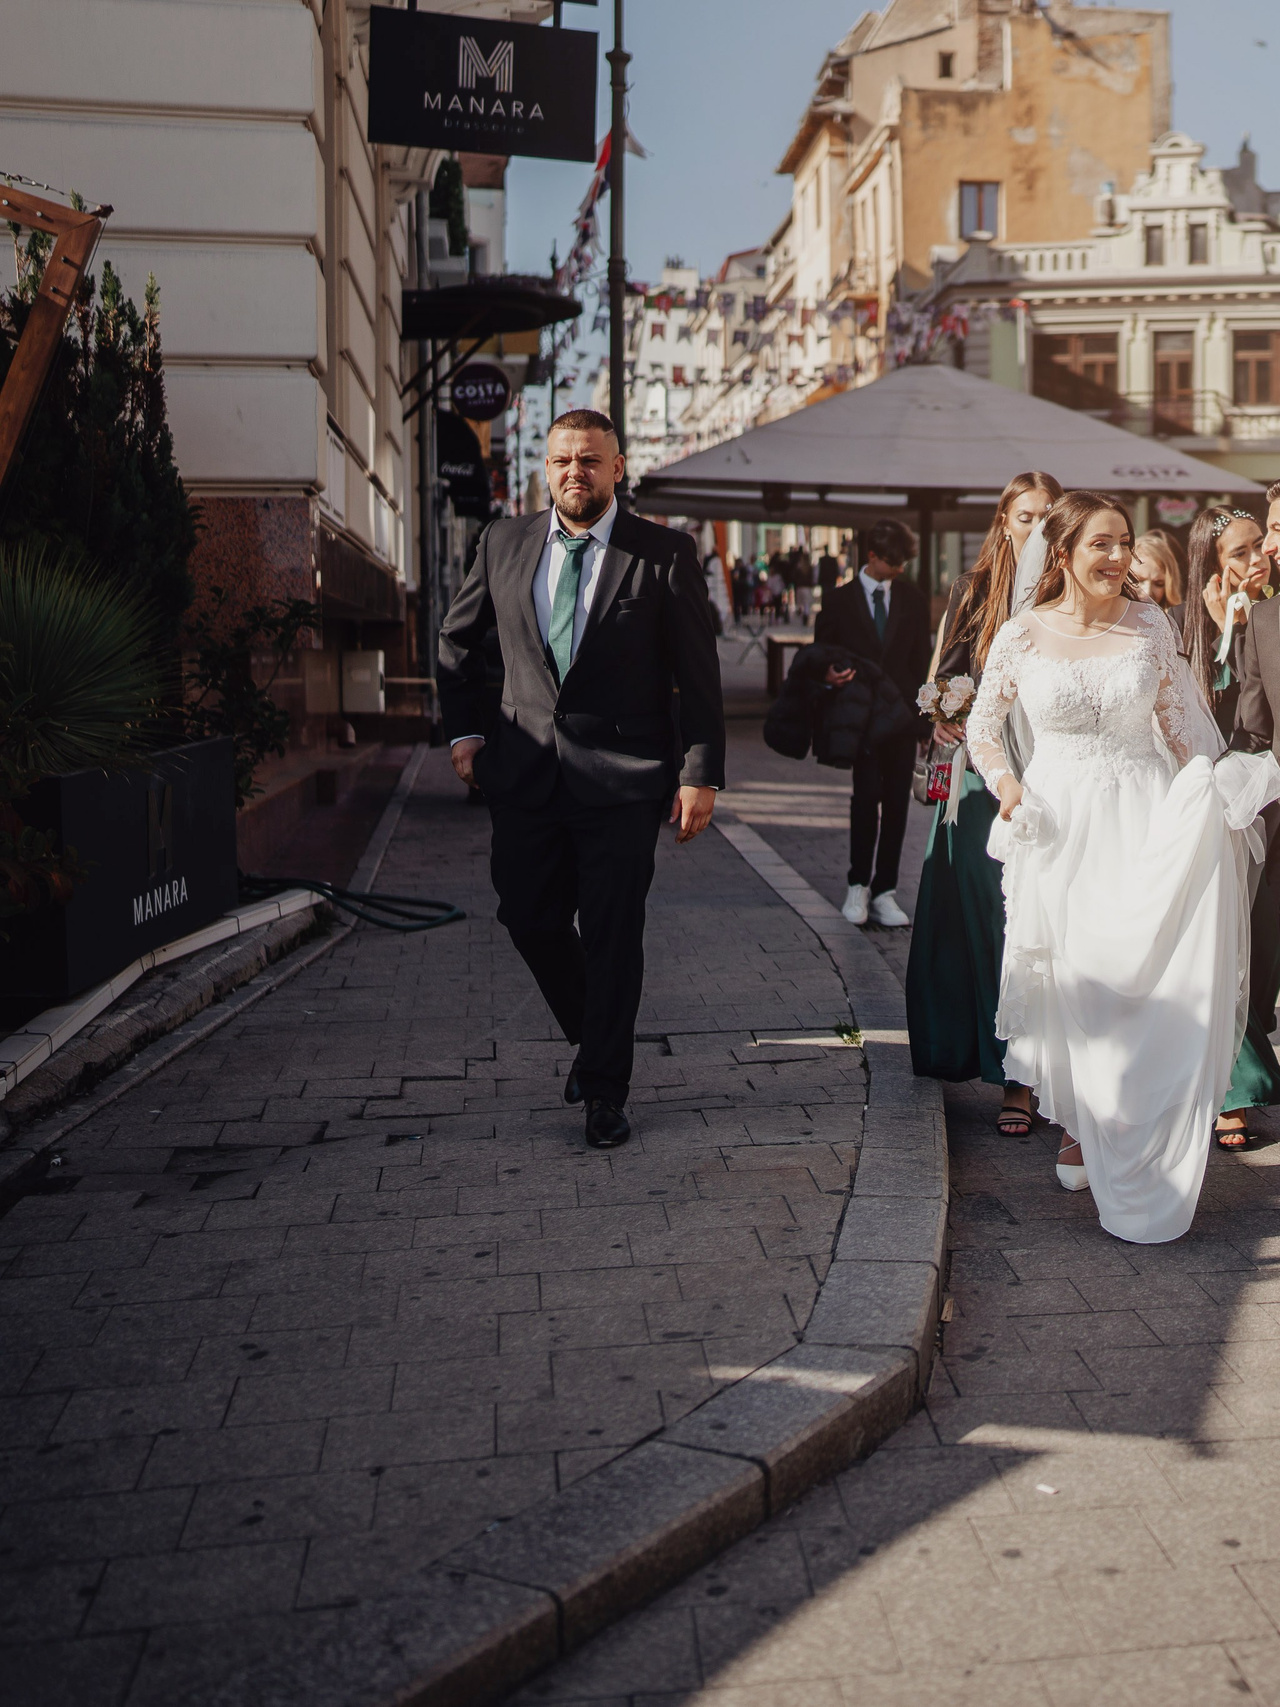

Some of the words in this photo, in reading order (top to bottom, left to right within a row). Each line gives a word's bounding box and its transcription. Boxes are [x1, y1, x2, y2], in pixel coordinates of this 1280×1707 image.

[423, 91, 545, 121] MANARA
[454, 382, 505, 400] COSTA
[133, 876, 189, 926] MANARA
